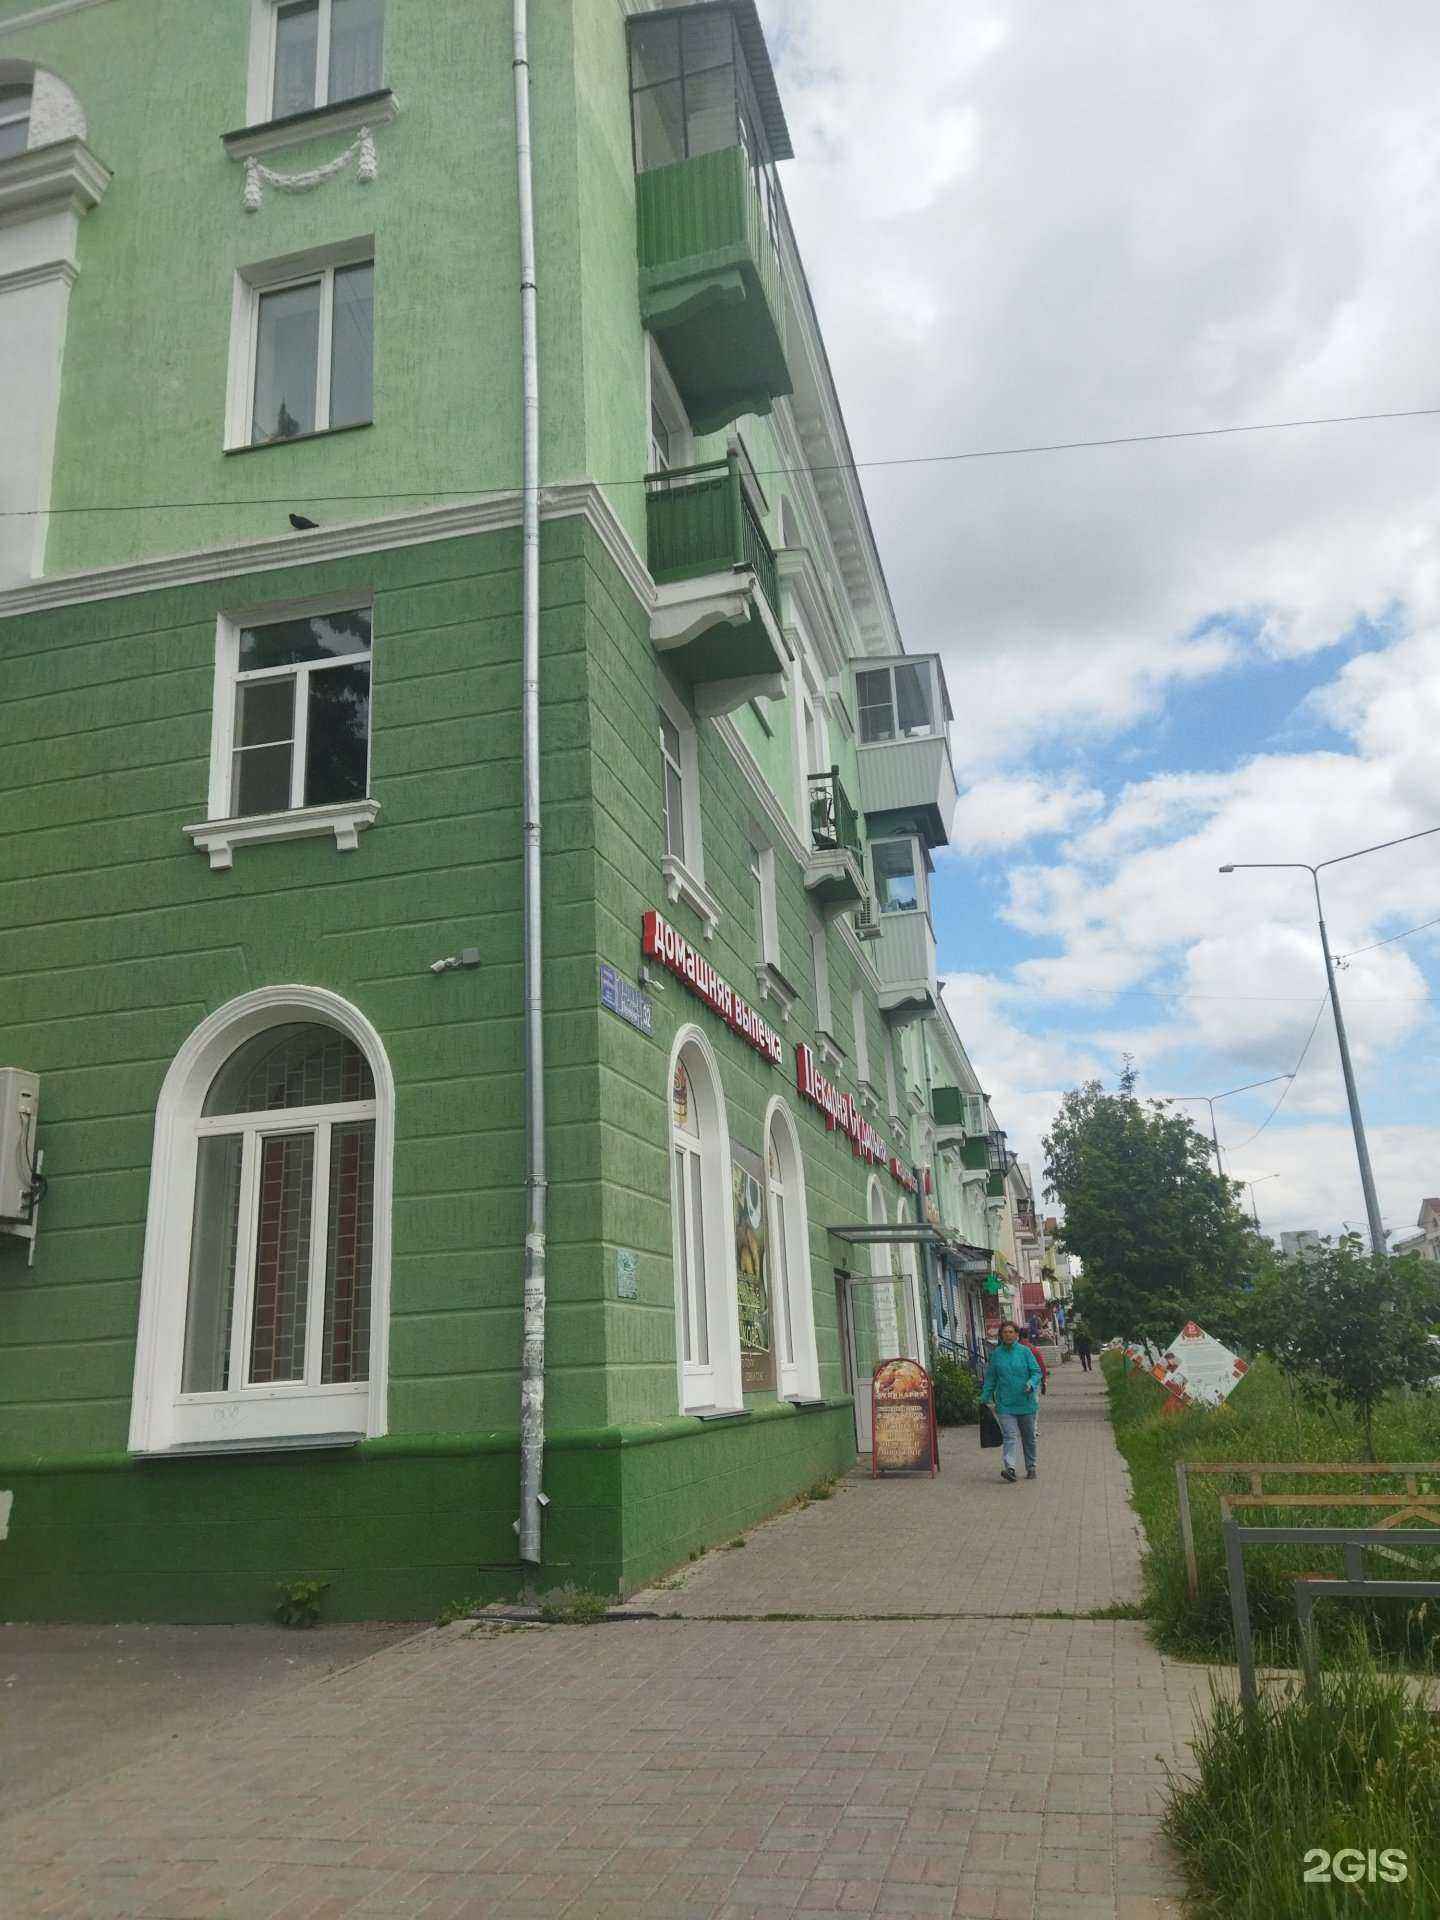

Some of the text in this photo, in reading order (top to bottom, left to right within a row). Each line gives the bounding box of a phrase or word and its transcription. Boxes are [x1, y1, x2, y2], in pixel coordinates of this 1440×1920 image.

[655, 911, 783, 1064] домашняя выпечка
[803, 1042, 849, 1130] Пекарня
